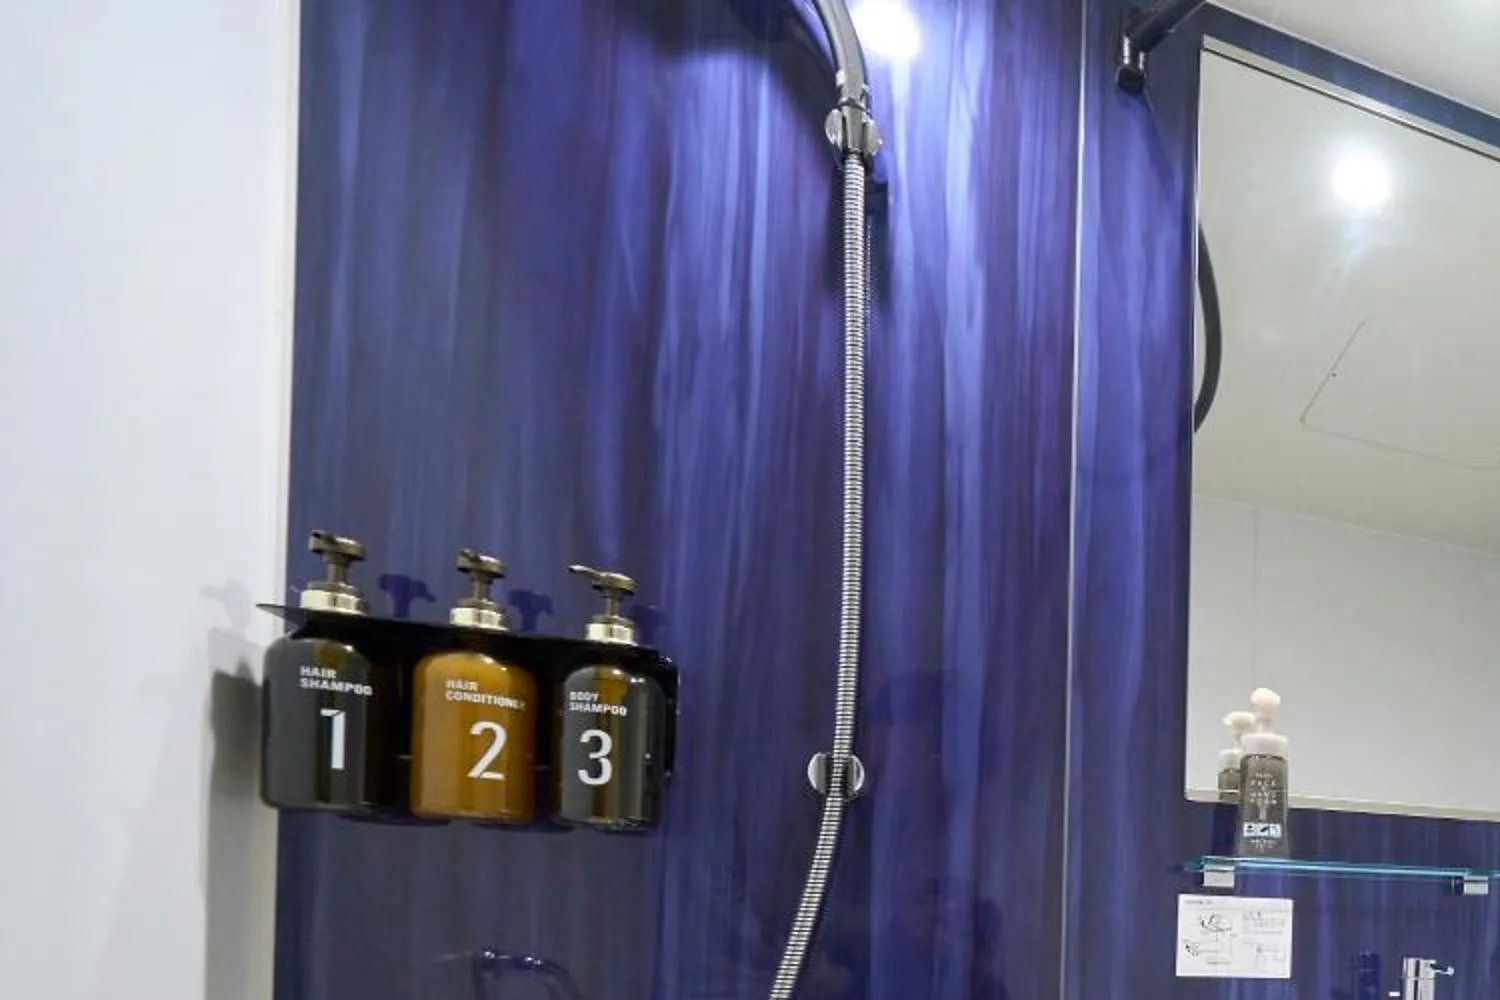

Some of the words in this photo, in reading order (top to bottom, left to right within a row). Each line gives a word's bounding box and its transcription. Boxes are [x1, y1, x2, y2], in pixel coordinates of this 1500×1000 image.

[300, 665, 337, 678] HAIR
[299, 677, 374, 696] SHAMPOO
[447, 679, 479, 691] HAIR
[569, 701, 628, 717] SHAMPOO
[320, 708, 346, 770] 1
[467, 721, 507, 780] 2
[578, 729, 613, 786] 3
